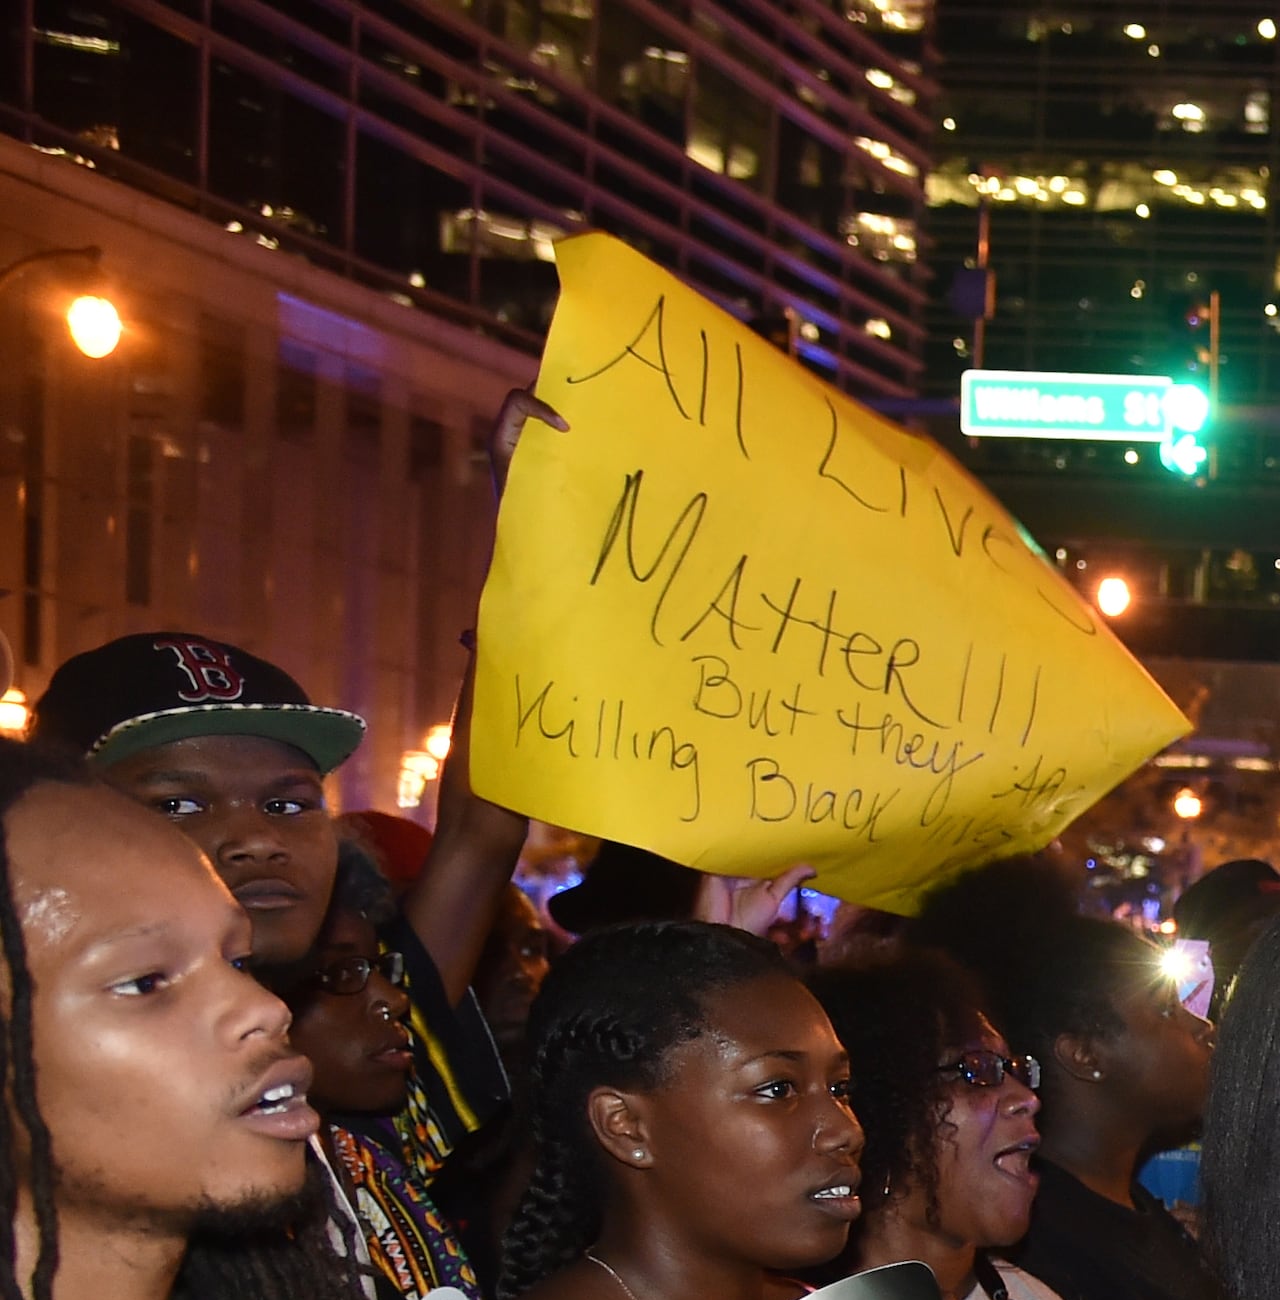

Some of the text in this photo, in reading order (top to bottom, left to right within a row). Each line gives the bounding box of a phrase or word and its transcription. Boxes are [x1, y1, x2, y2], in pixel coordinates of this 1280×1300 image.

[974, 386, 1105, 424] Williams
[153, 641, 245, 702] B
[515, 673, 701, 822] Killing
